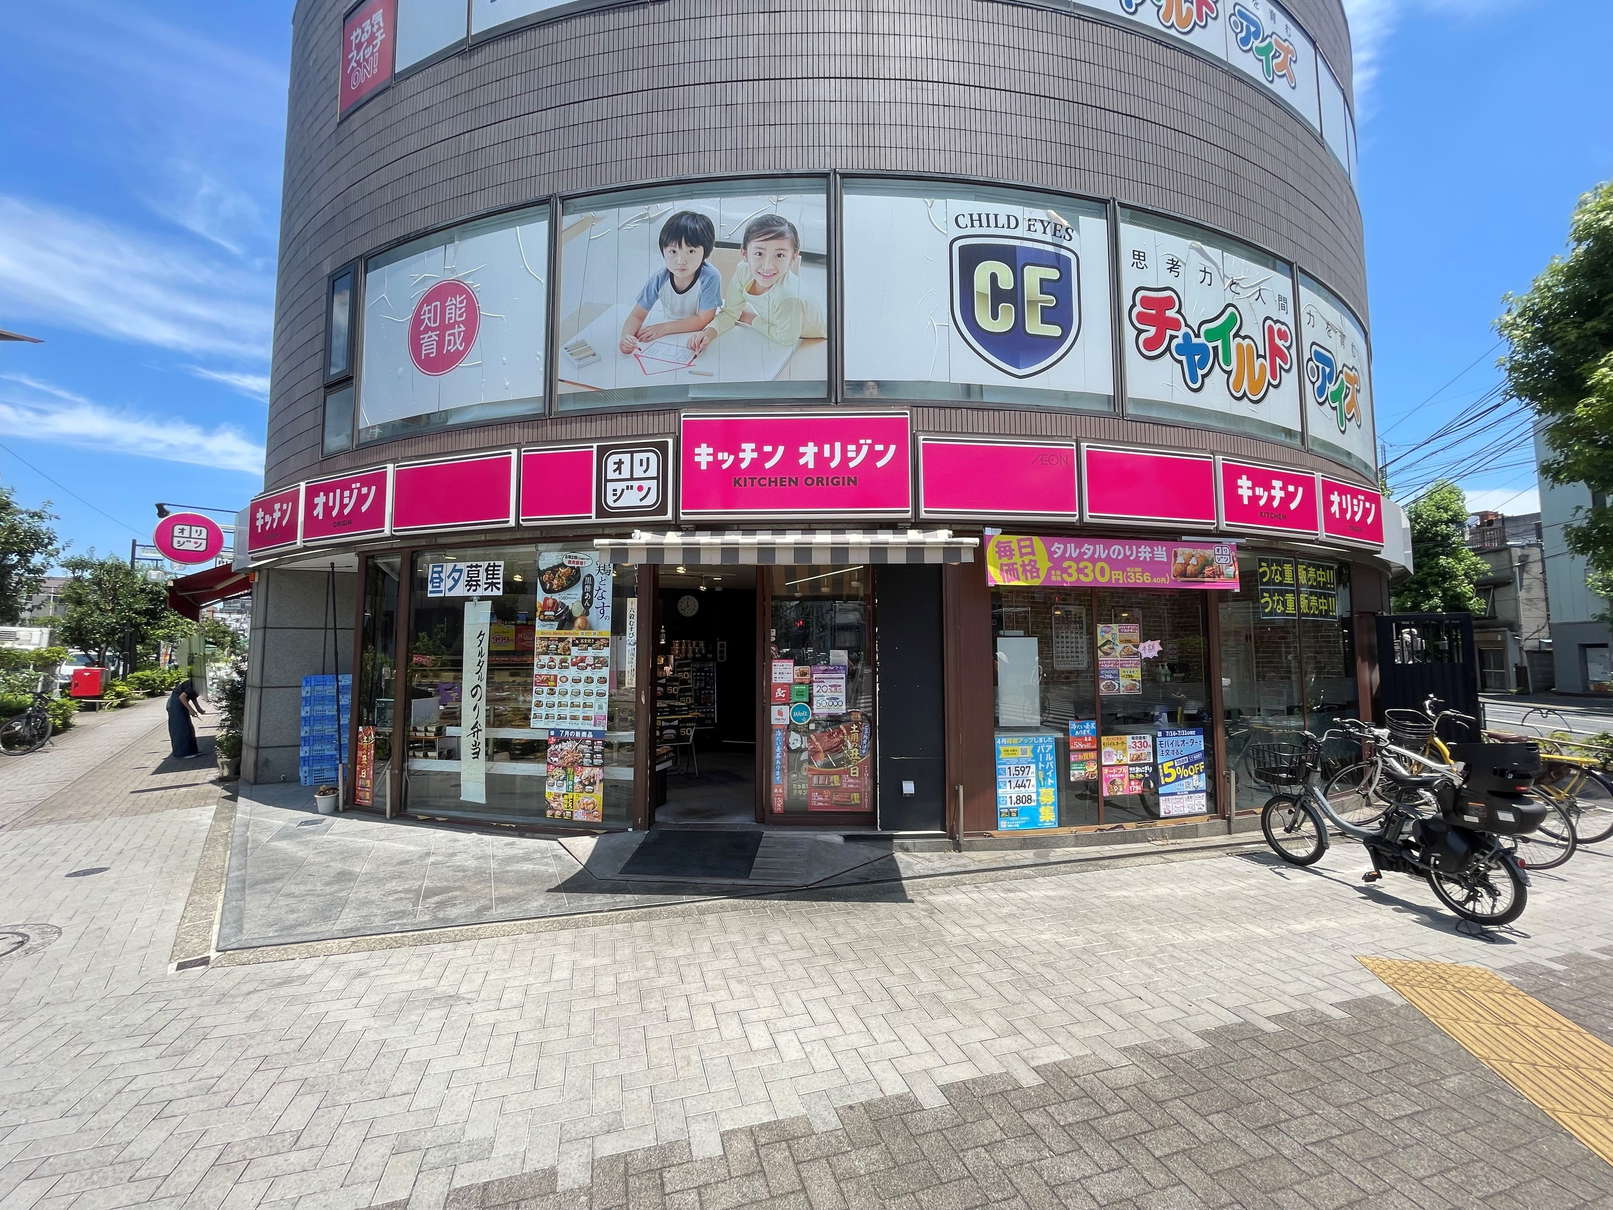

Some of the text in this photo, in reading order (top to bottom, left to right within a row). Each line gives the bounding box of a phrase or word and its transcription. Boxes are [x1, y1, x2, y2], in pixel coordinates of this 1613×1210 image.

[348, 29, 386, 73] スイッチ
[1231, 6, 1296, 87] アイズ
[351, 53, 379, 89] ON!
[954, 211, 1074, 242] CHILD EYES
[419, 295, 466, 329] 知能
[973, 261, 1061, 337] CE
[418, 324, 466, 359] 育成
[1131, 289, 1291, 402] チャイルド
[1308, 344, 1362, 431] アイズ
[612, 456, 650, 475] オリ
[694, 439, 897, 470] キッチン オリジン
[612, 484, 651, 504] ジン
[732, 476, 858, 488] KITCHEN ORIGIN
[256, 482, 377, 533] キッチン オリジン
[1237, 474, 1376, 525] キッチン オリジン
[994, 537, 1037, 561] 毎日
[1050, 542, 1168, 563] タルタルのり弁当
[429, 562, 502, 595] 昼夕募集
[999, 558, 1042, 583] 価格
[1259, 562, 1335, 588] うな重 販売中!!
[1261, 592, 1337, 616] うな重 販売中!!
[466, 629, 487, 760] タルタルのり弁当
[1007, 765, 1031, 777] 1,597
[1037, 745, 1045, 770] パート
[1045, 744, 1054, 786] アルバイト
[1163, 761, 1206, 783] 5%OFF
[1008, 779, 1032, 790] 1,447
[1008, 794, 1033, 806] 1,808
